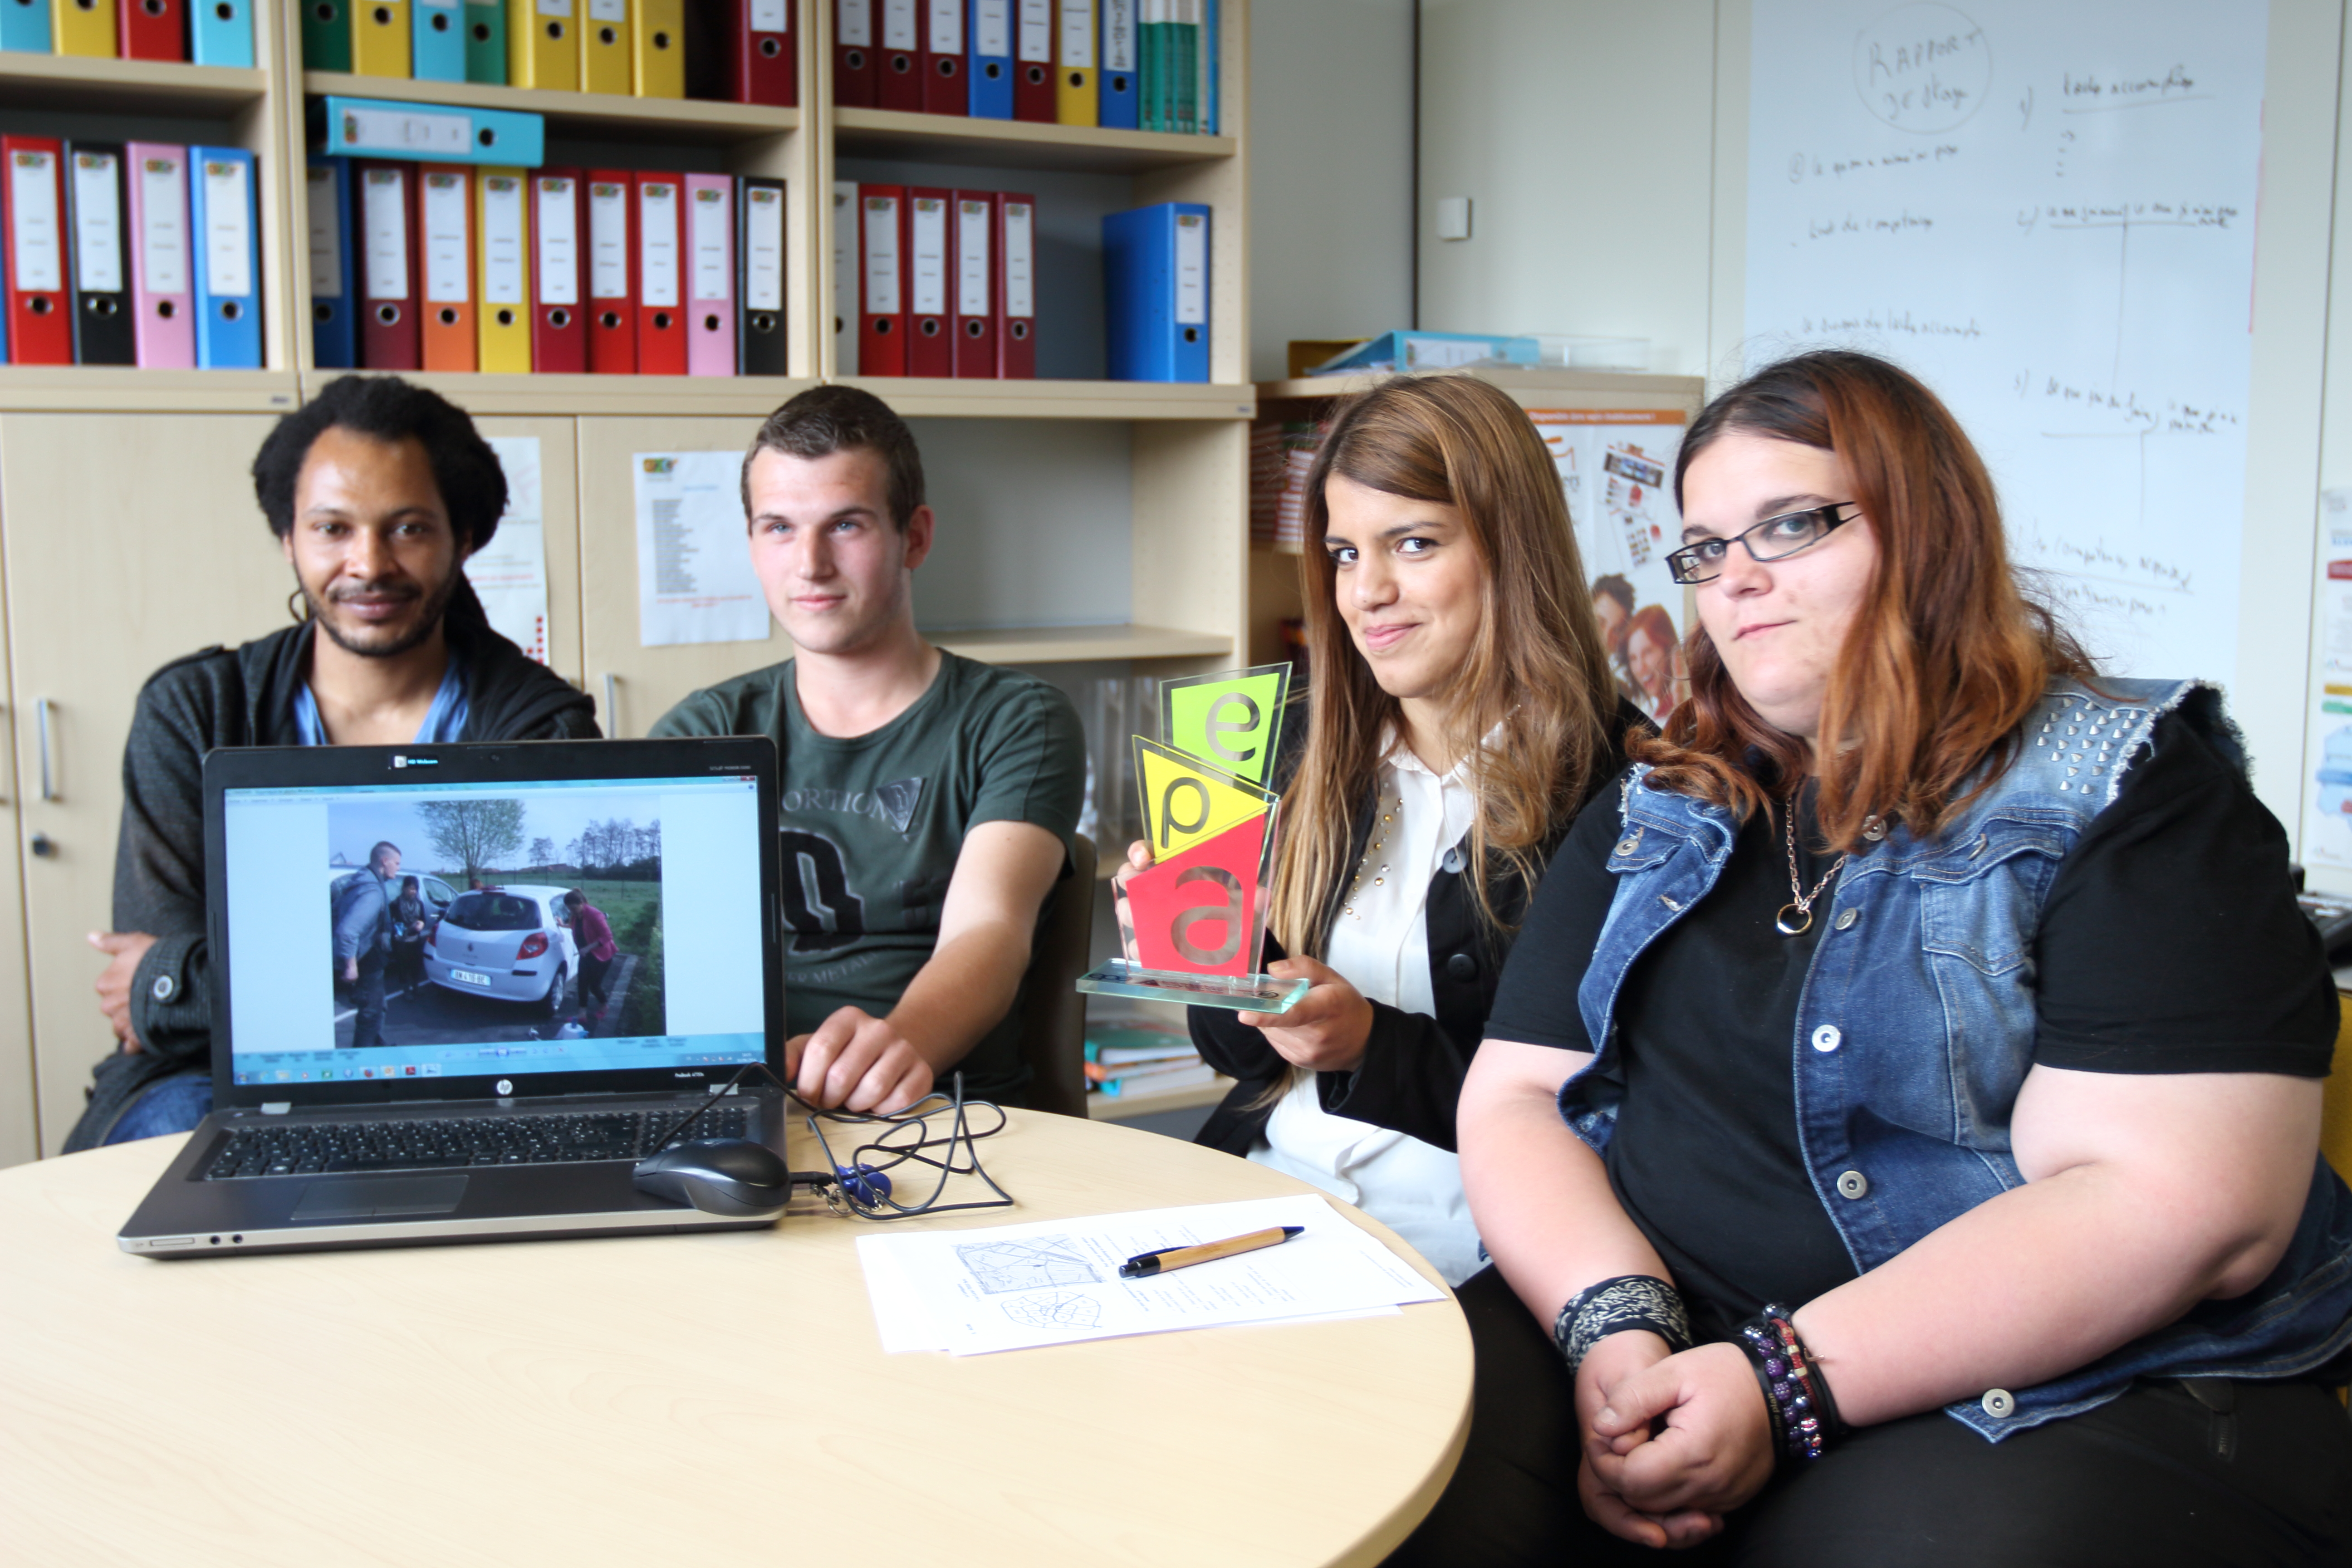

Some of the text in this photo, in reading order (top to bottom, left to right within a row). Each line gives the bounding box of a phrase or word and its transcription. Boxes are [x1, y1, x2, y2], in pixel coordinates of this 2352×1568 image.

[1869, 28, 1982, 88] RAPPORT
[1205, 691, 1261, 762] e
[1161, 777, 1210, 849] p
[1171, 866, 1244, 965] a
